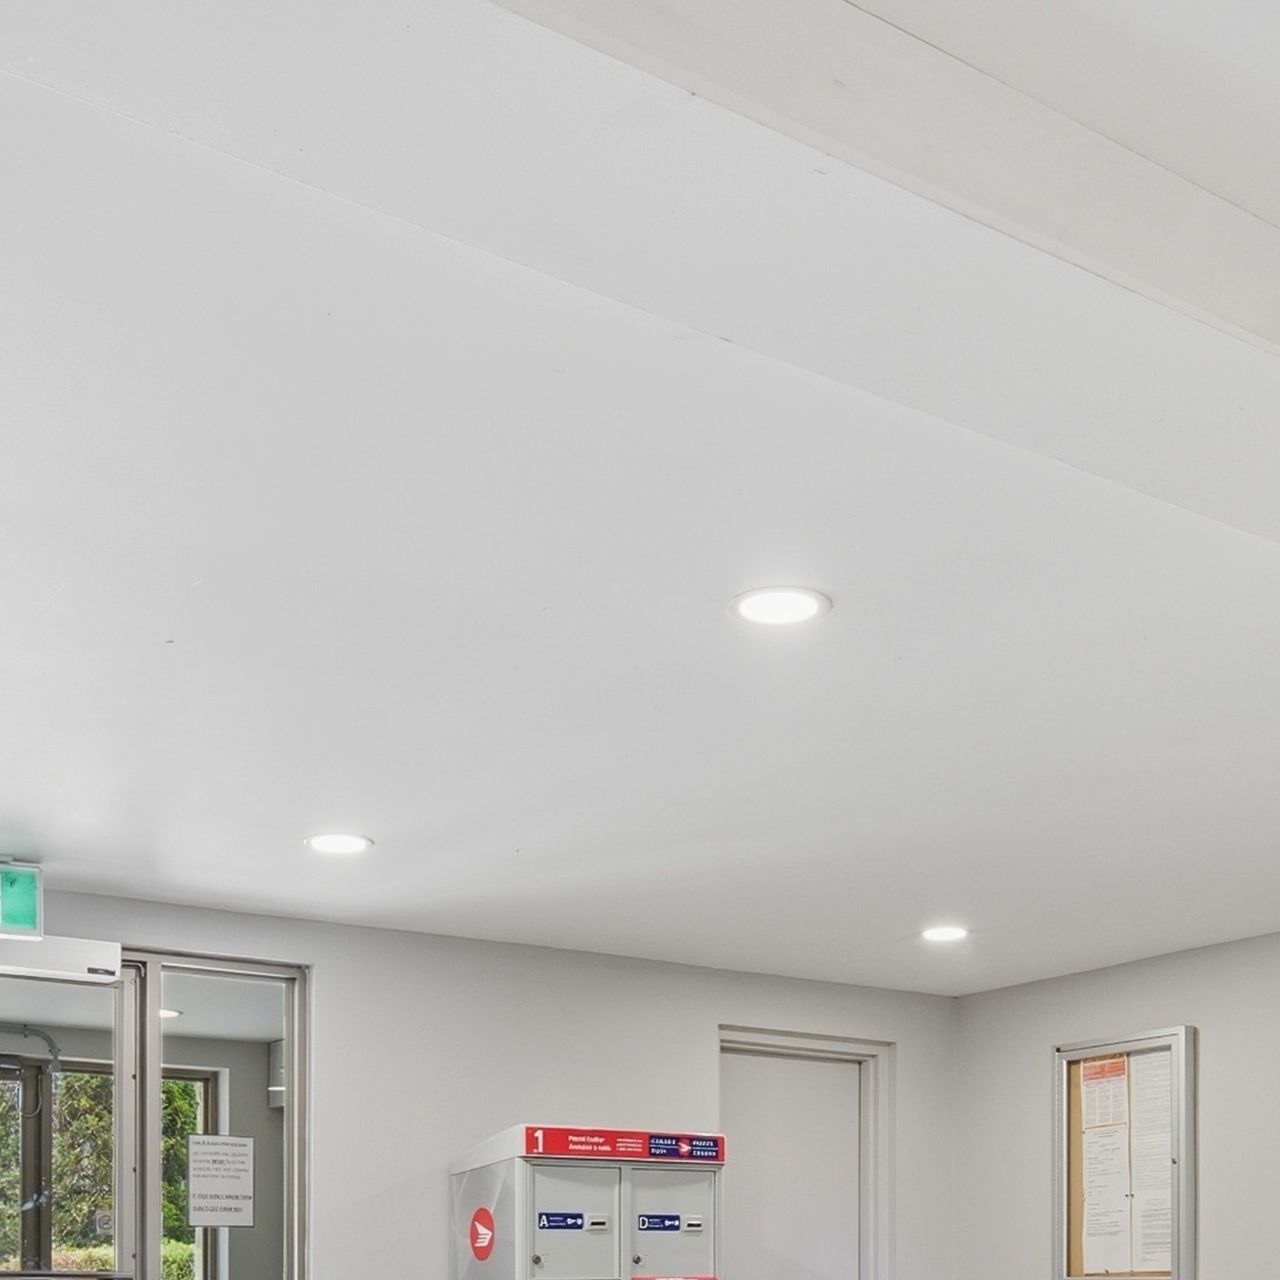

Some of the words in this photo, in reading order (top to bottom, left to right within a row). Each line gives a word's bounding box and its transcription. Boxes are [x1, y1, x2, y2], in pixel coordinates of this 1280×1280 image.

[533, 1129, 544, 1153] 1
[539, 1215, 549, 1228] A
[639, 1216, 649, 1229] D
